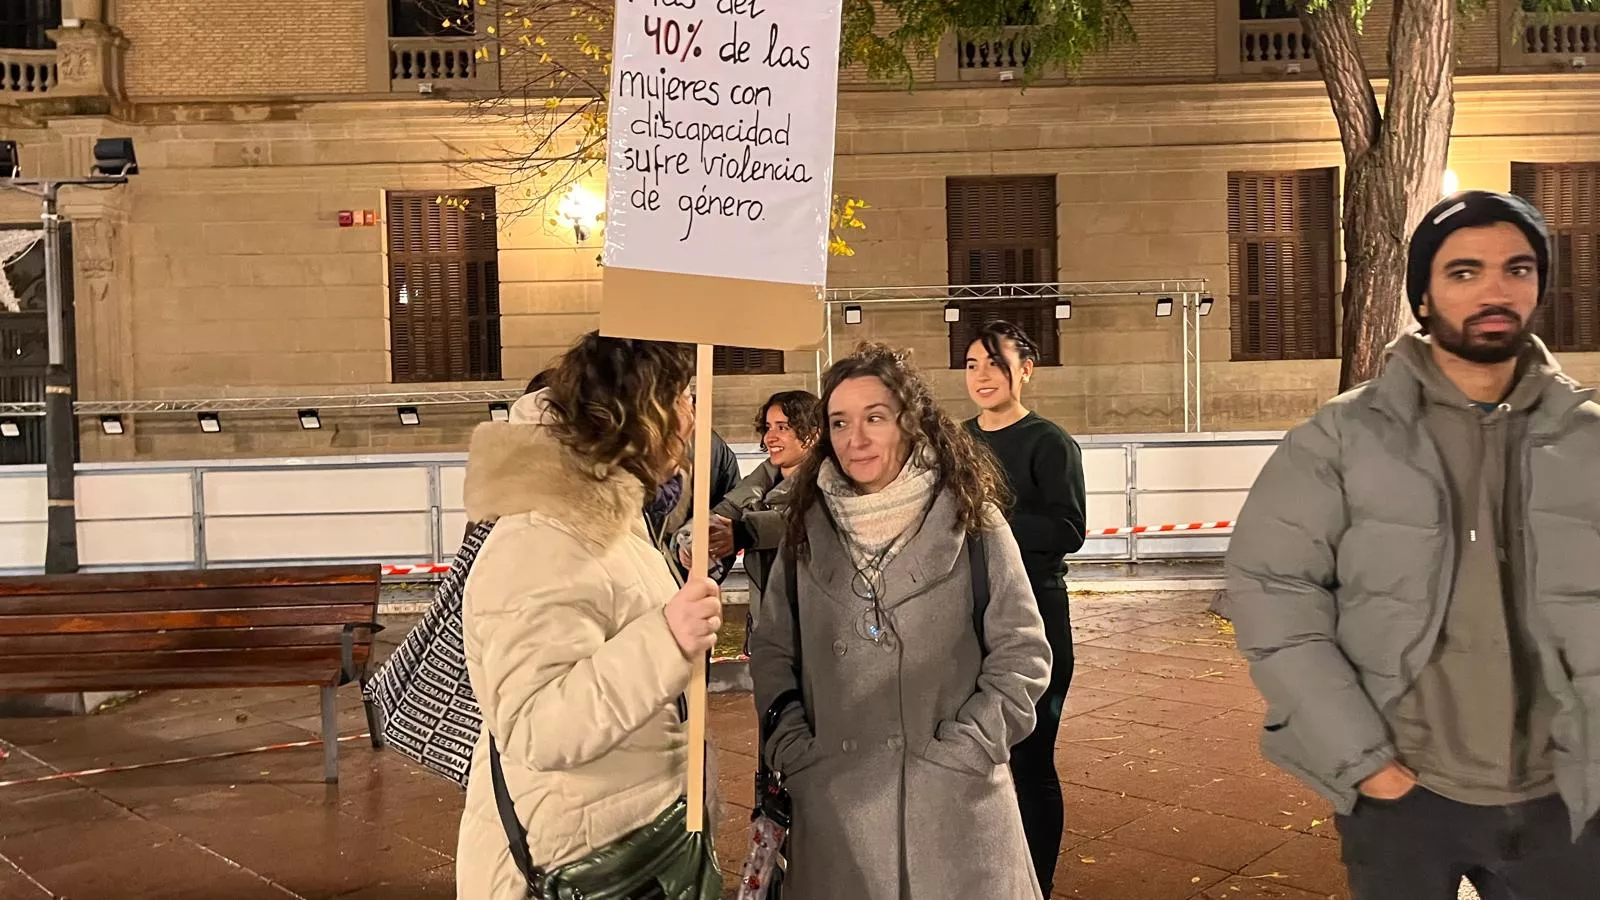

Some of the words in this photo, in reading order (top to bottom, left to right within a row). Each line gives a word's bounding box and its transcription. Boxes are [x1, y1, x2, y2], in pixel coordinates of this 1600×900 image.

[644, 15, 703, 62] 40%
[719, 21, 750, 64] de
[762, 23, 810, 69] las
[619, 68, 719, 126] mujeres
[730, 85, 771, 107] con
[631, 100, 790, 162] discapacidad
[624, 144, 689, 185] sufre
[703, 145, 812, 183] violencia
[631, 176, 660, 210] de
[678, 185, 765, 241] género.
[420, 665, 455, 690] ZEEMAN
[427, 652, 460, 678] ZEEMAN
[413, 676, 451, 703] ZEEMAN
[400, 702, 437, 727] ZEEMAN
[407, 691, 444, 716] ZEEMAN
[393, 714, 430, 739] ZEEMAN
[446, 711, 480, 731] ZEEMA
[387, 725, 423, 751] ZEEMAN
[431, 735, 472, 758] ZEEMAN
[426, 748, 465, 770] ZEEMAN
